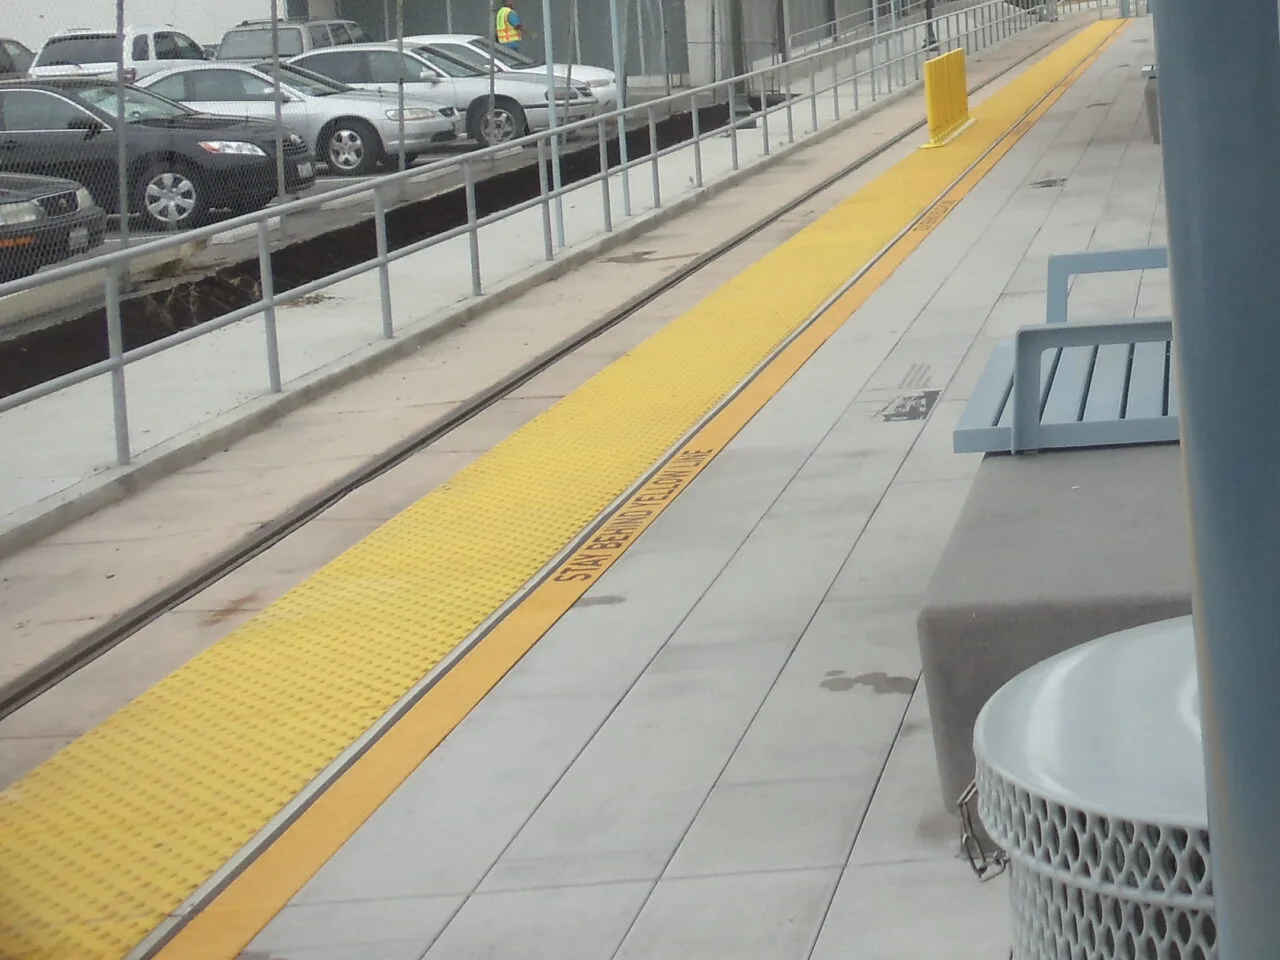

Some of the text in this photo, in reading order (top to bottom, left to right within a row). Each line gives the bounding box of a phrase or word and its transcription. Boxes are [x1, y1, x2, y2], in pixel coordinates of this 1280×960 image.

[553, 448, 715, 582] STAY BEHIND YELLOW LINE
